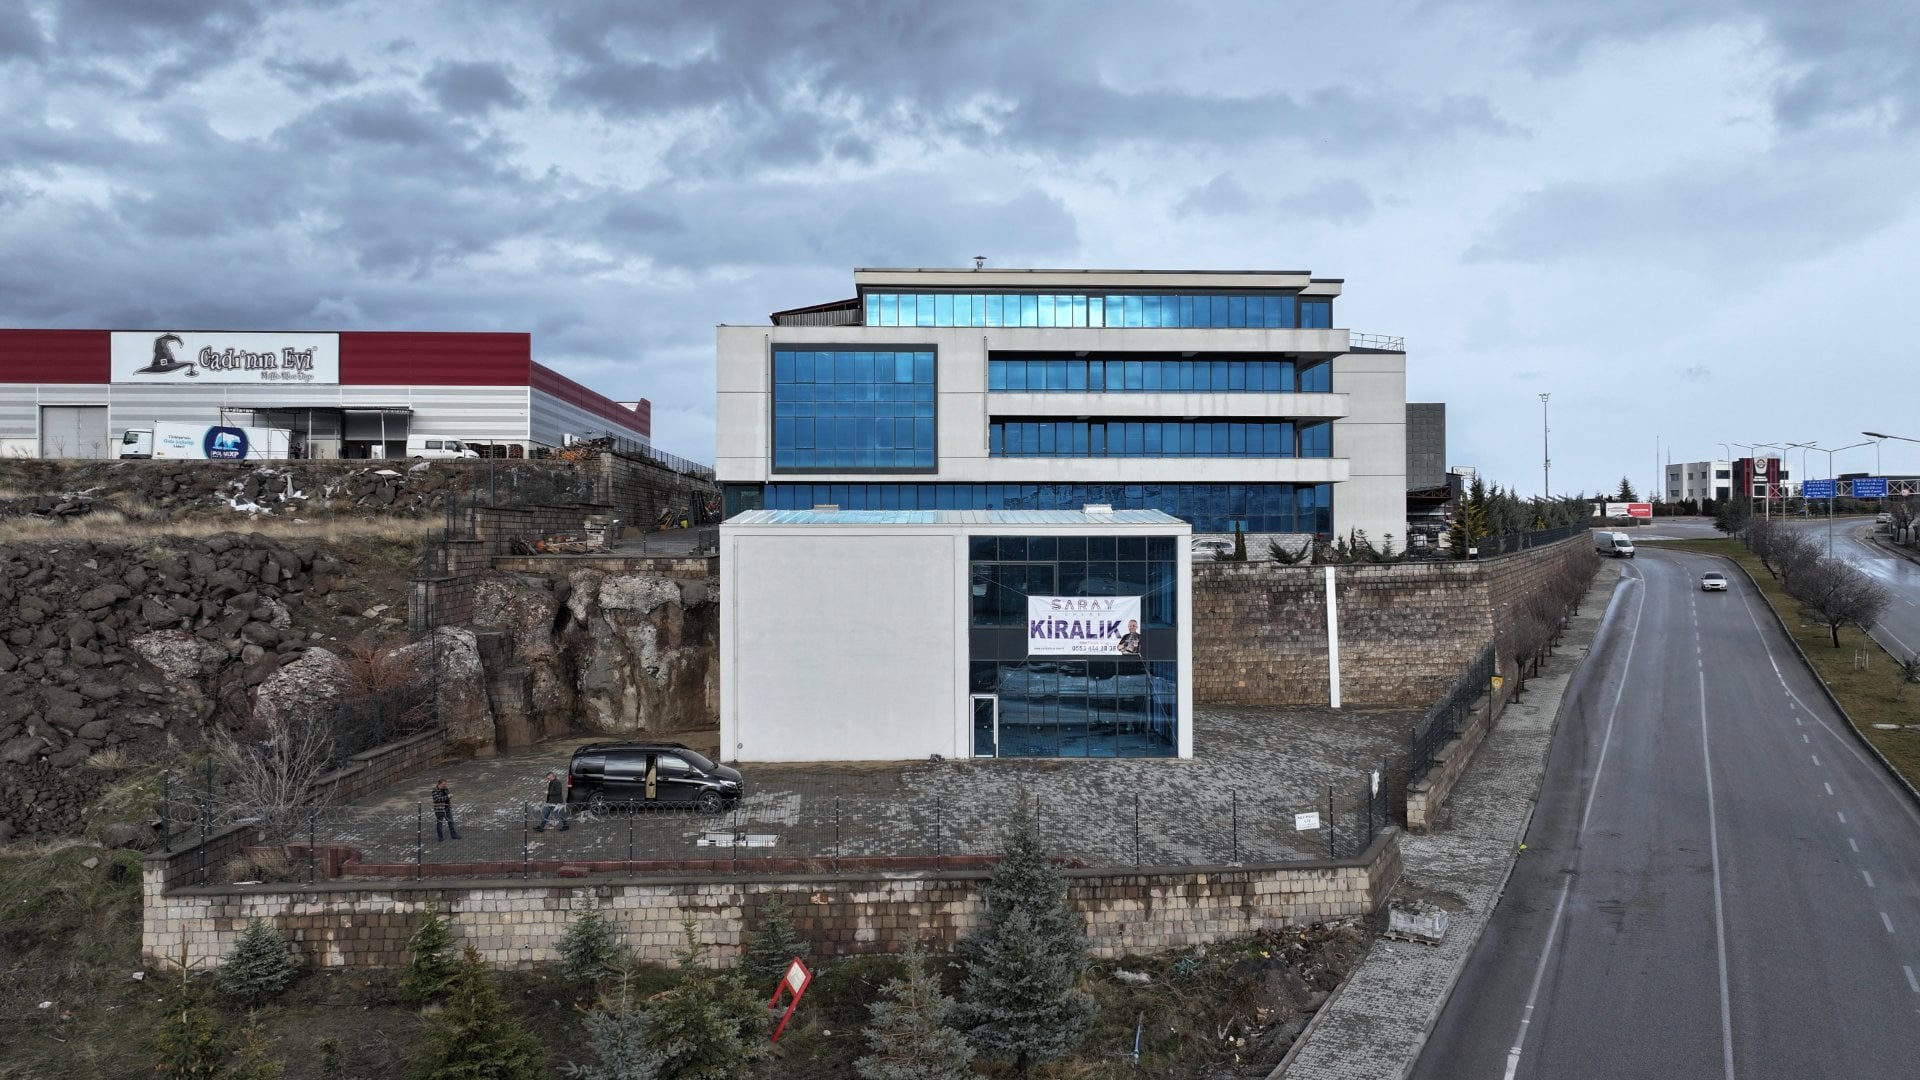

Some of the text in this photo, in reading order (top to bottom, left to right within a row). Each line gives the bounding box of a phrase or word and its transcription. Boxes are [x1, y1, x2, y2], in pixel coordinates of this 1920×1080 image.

[281, 346, 314, 370] Evi
[1051, 599, 1115, 610] SARAY
[1030, 615, 1122, 639] KİRALIK
